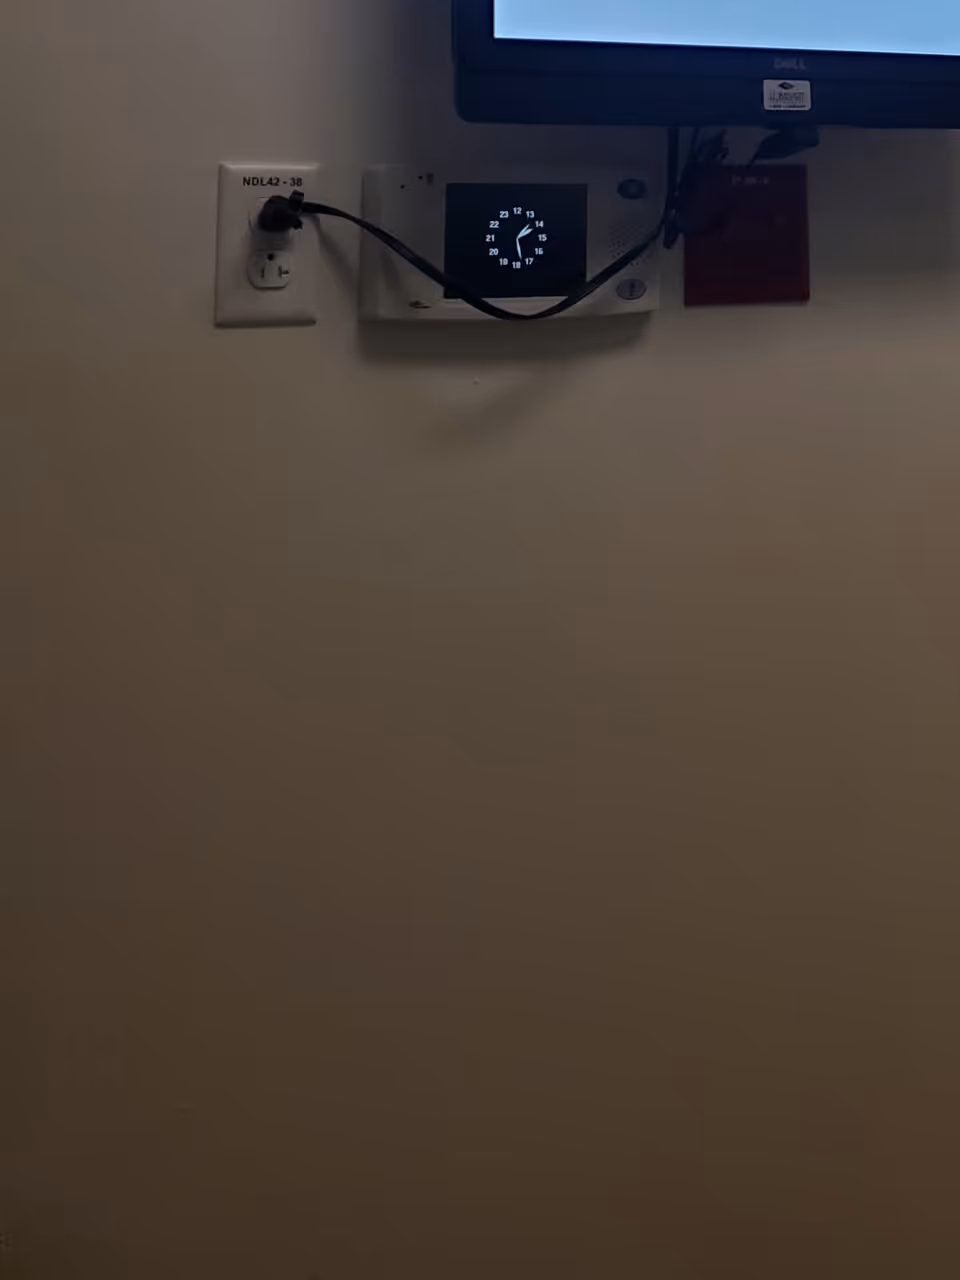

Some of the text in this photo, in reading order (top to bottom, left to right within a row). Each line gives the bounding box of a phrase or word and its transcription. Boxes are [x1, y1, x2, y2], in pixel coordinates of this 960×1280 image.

[243, 177, 280, 186] NDL42
[290, 177, 302, 186] 38
[499, 210, 509, 218] 23
[526, 210, 535, 218] 13
[489, 220, 499, 228] 22
[535, 220, 544, 228] 14
[485, 234, 495, 242] 21
[512, 261, 521, 269] 18
[525, 257, 534, 265] 17
